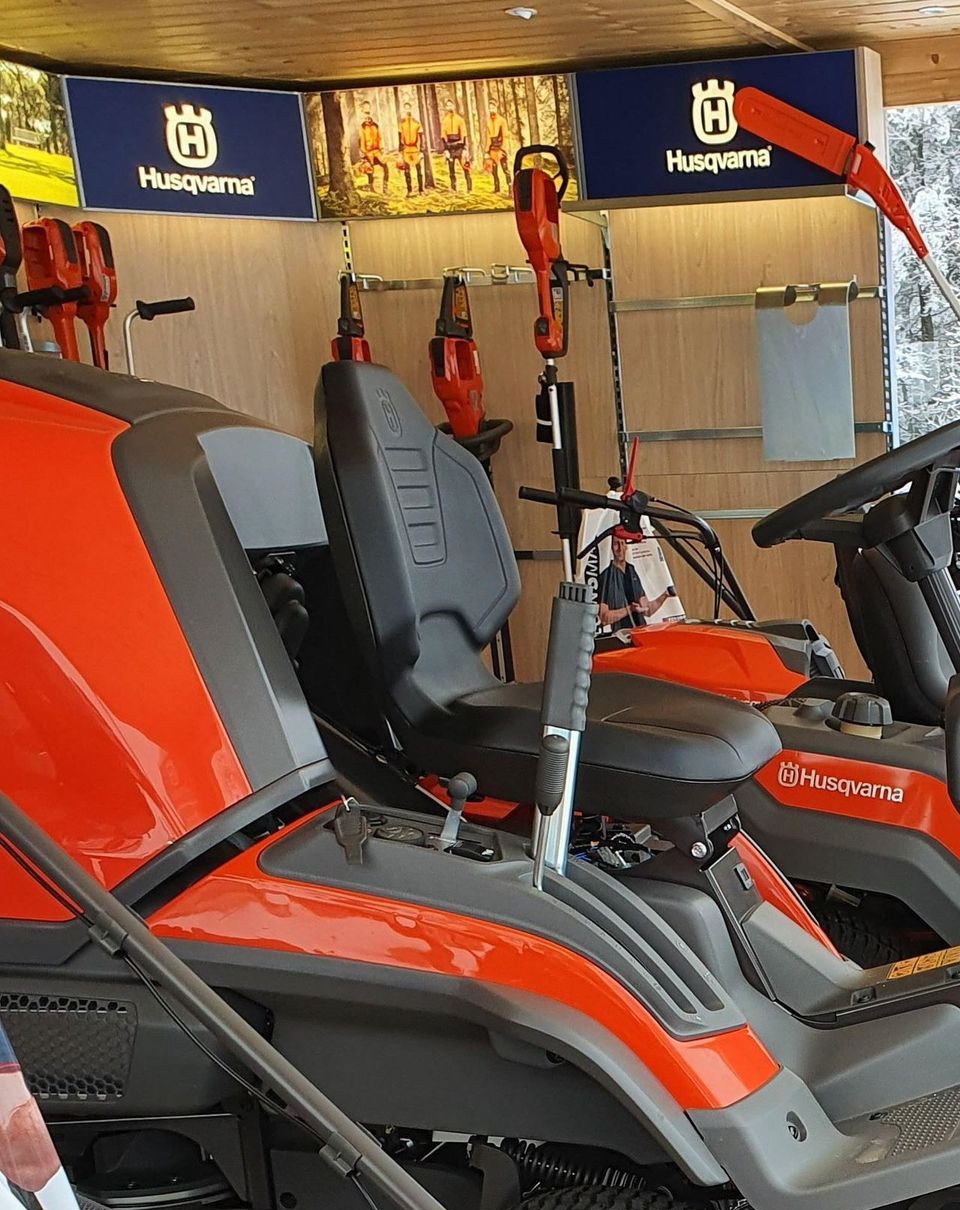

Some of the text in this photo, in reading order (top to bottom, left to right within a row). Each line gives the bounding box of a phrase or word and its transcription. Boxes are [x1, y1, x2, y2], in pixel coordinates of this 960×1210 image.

[666, 146, 772, 174] Husqvarna
[138, 166, 255, 195] Husqvarna
[800, 768, 904, 803] Husqvarna
